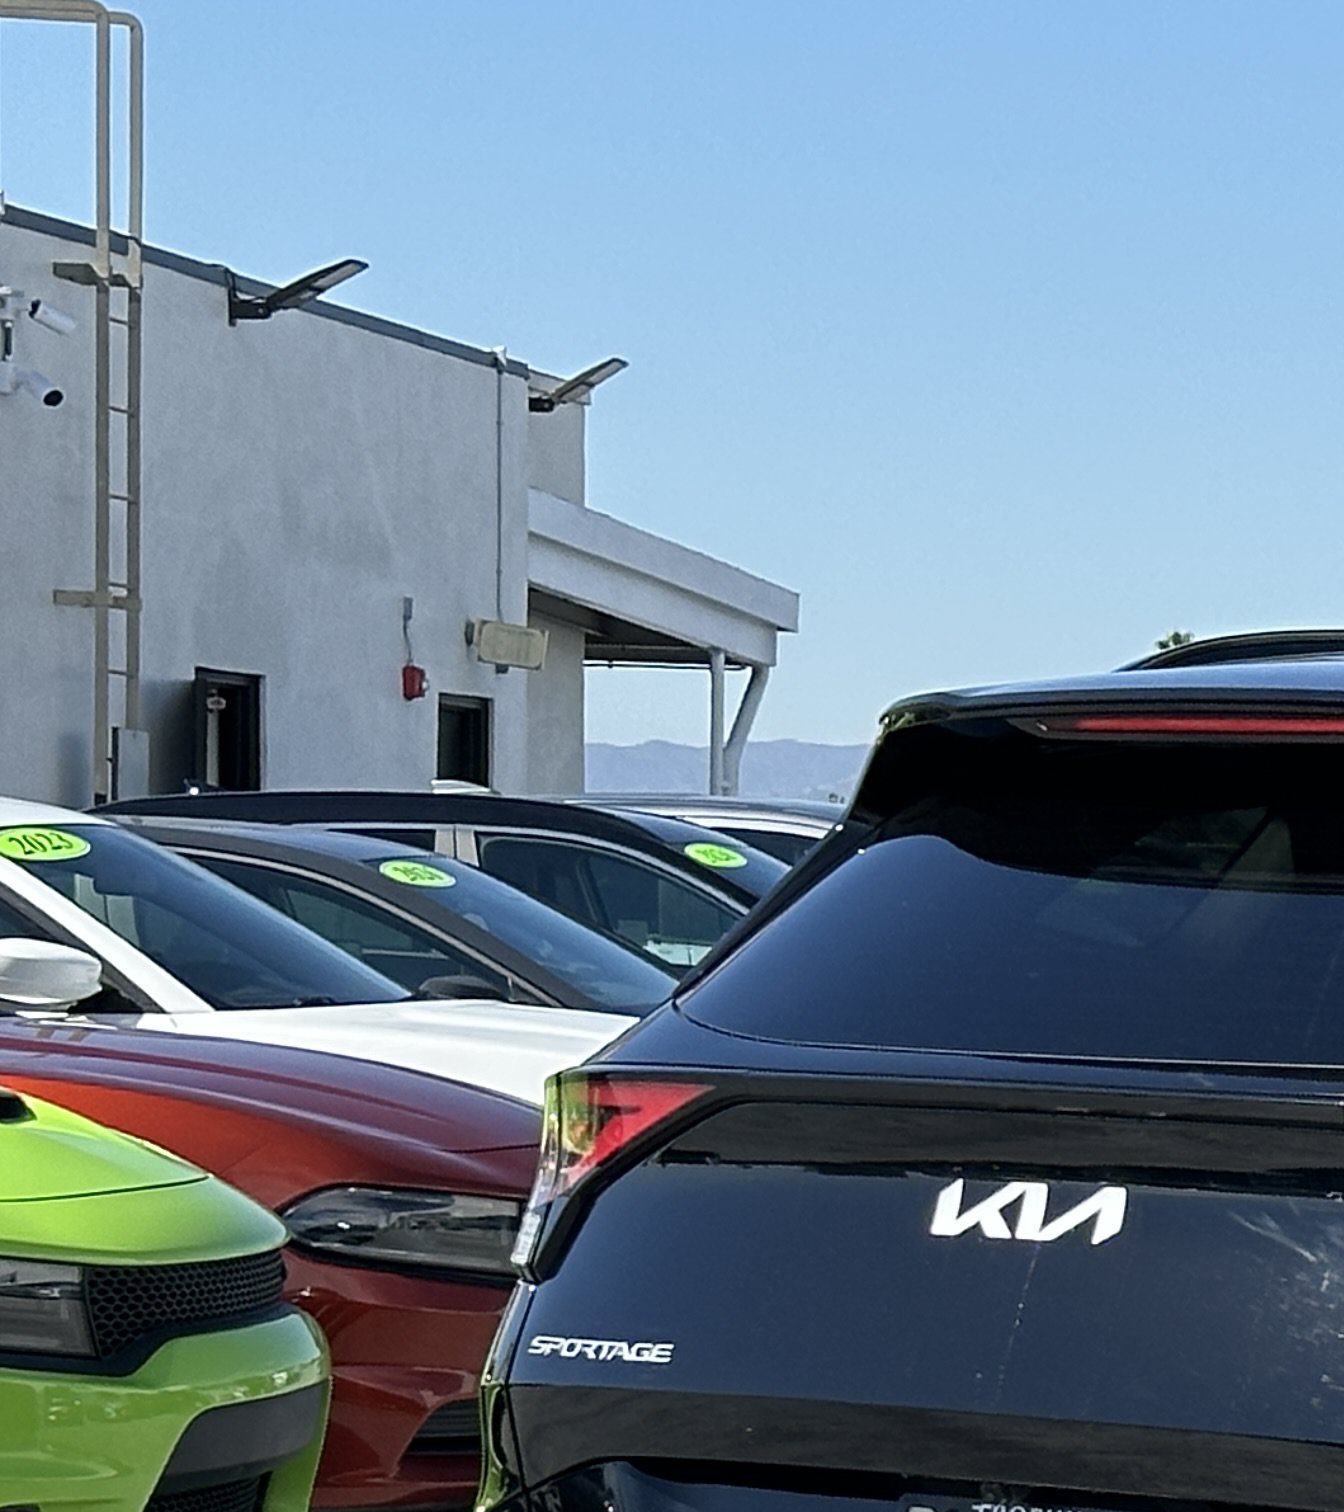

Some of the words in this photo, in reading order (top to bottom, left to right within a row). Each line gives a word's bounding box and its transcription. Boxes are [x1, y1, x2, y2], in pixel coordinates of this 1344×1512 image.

[8, 832, 74, 856] 2023
[930, 1177, 1128, 1246] KIA
[528, 1335, 675, 1363] SPORTAGE
